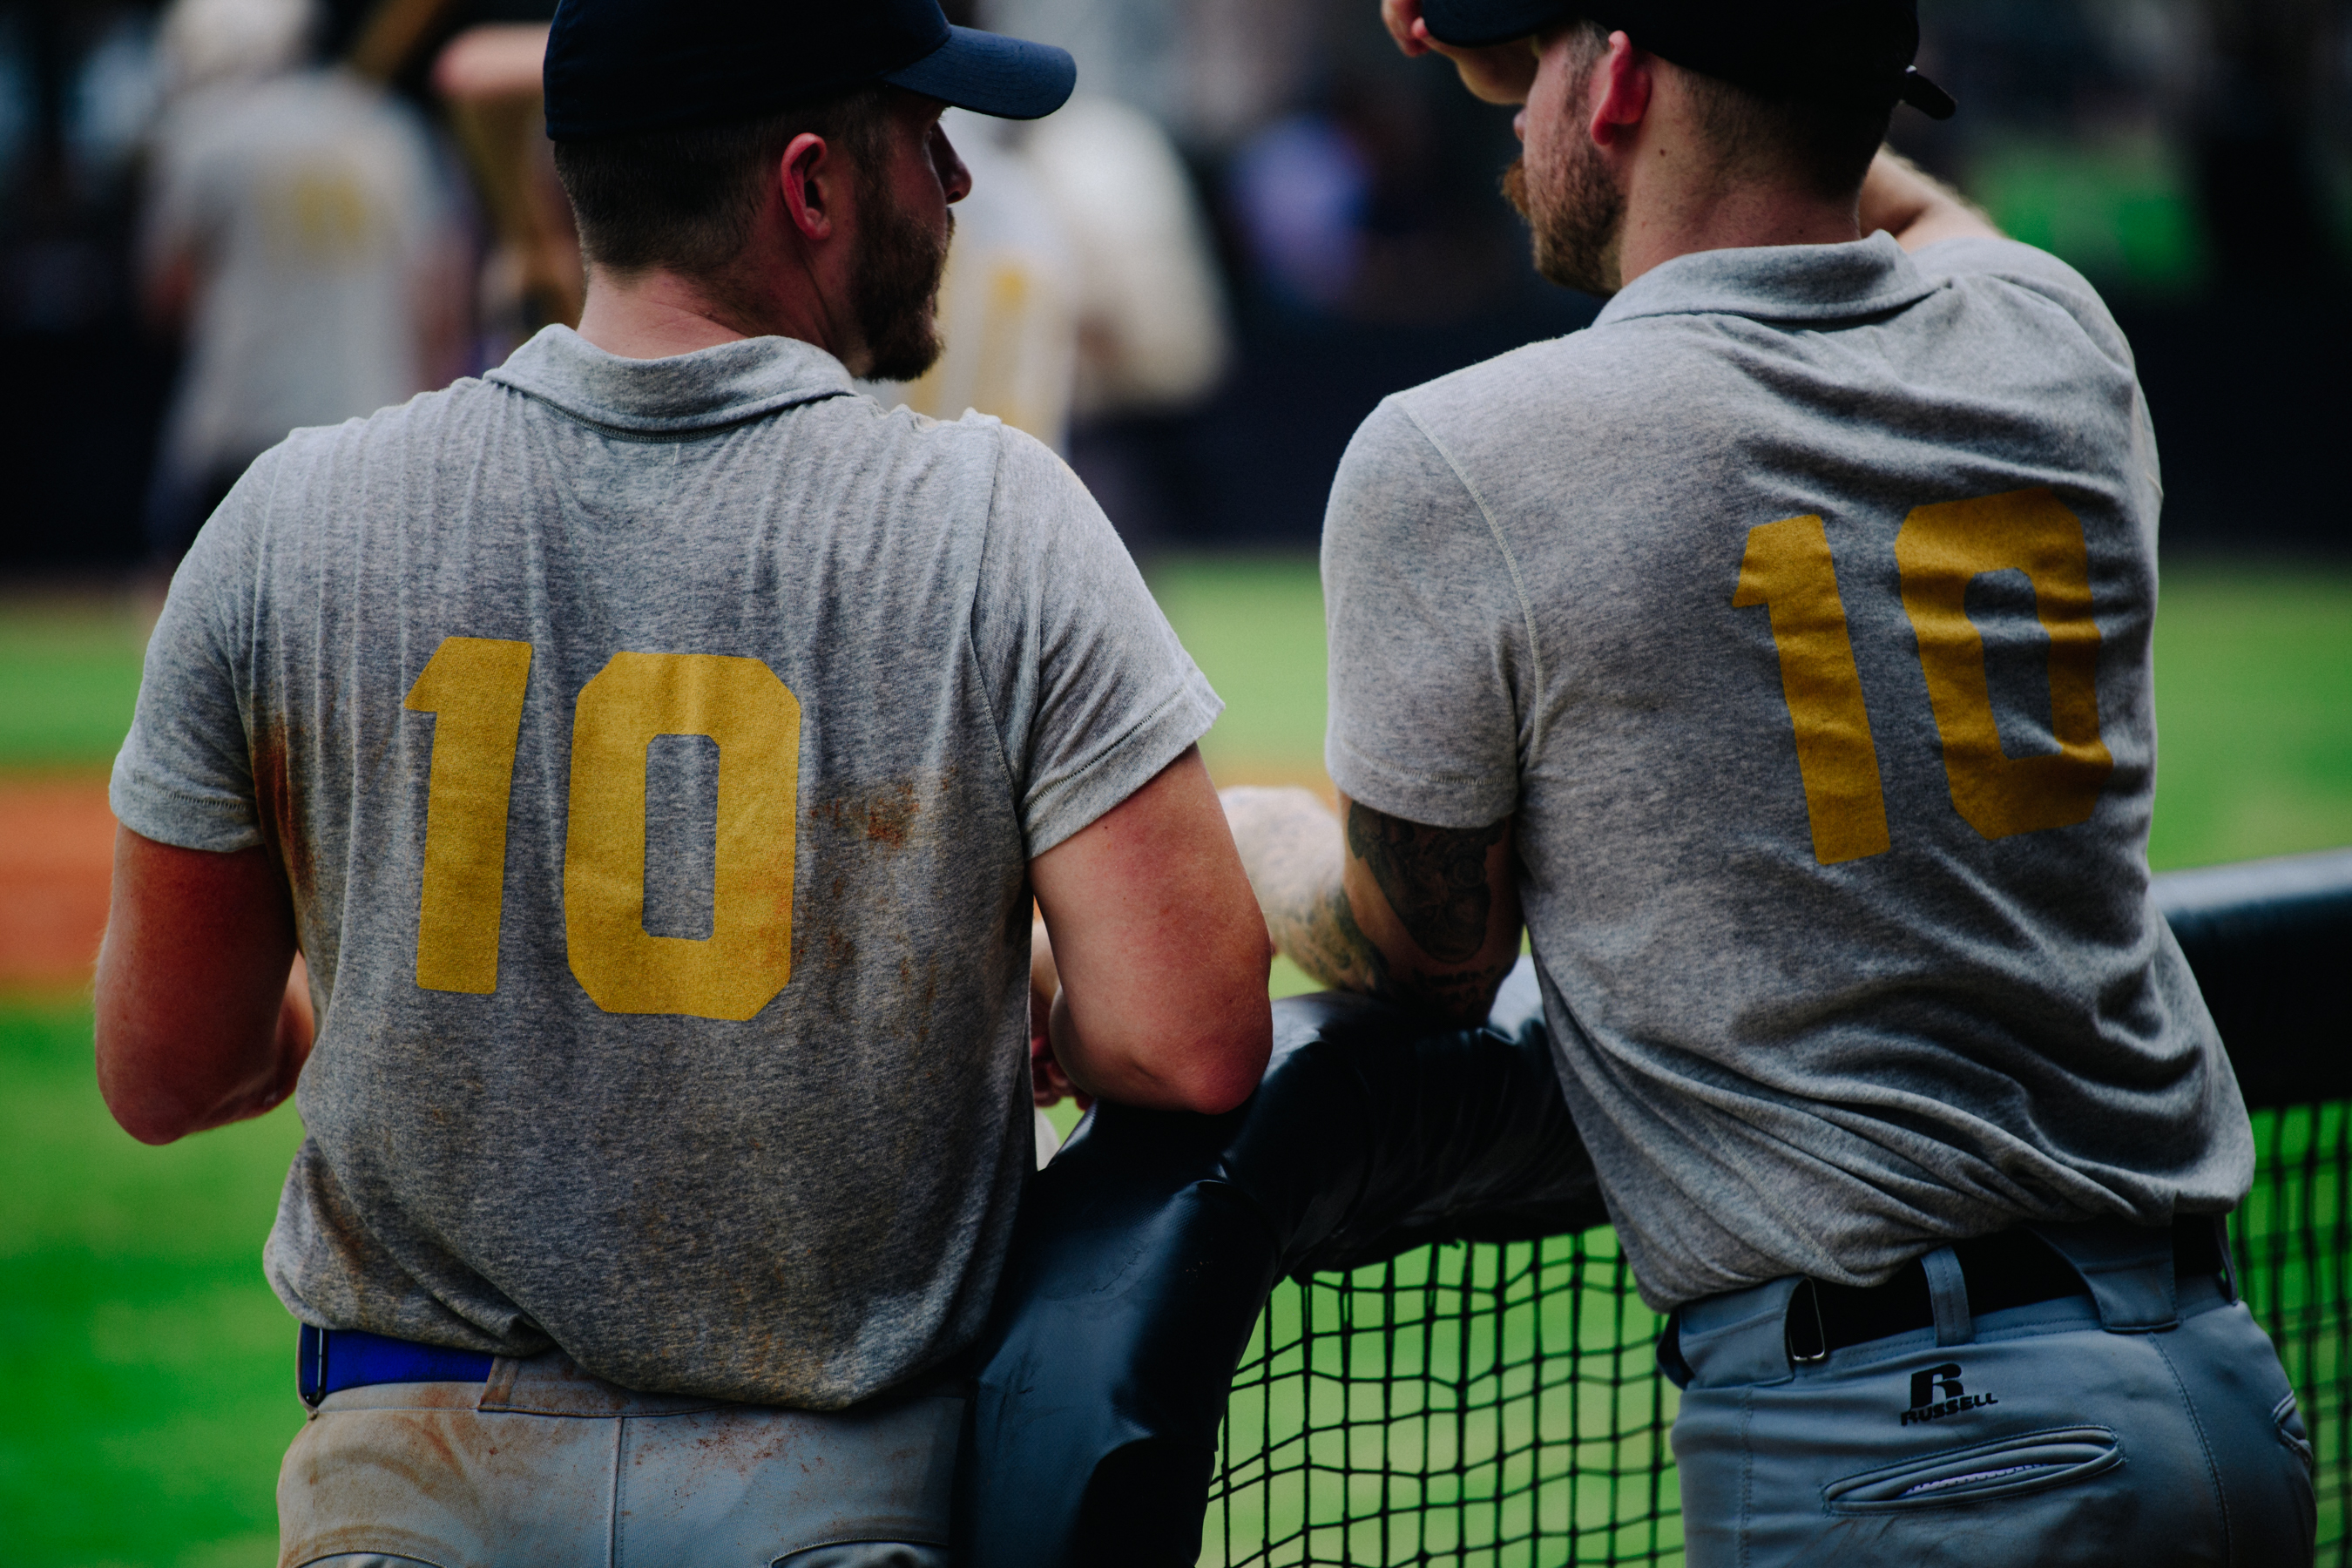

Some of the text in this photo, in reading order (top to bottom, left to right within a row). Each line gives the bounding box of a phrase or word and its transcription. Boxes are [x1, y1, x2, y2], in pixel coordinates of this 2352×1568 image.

[1732, 487, 2114, 865] 10
[402, 636, 801, 1022] 10
[1901, 1393, 1998, 1426] RUSSELL
[1910, 1363, 1963, 1409] R
